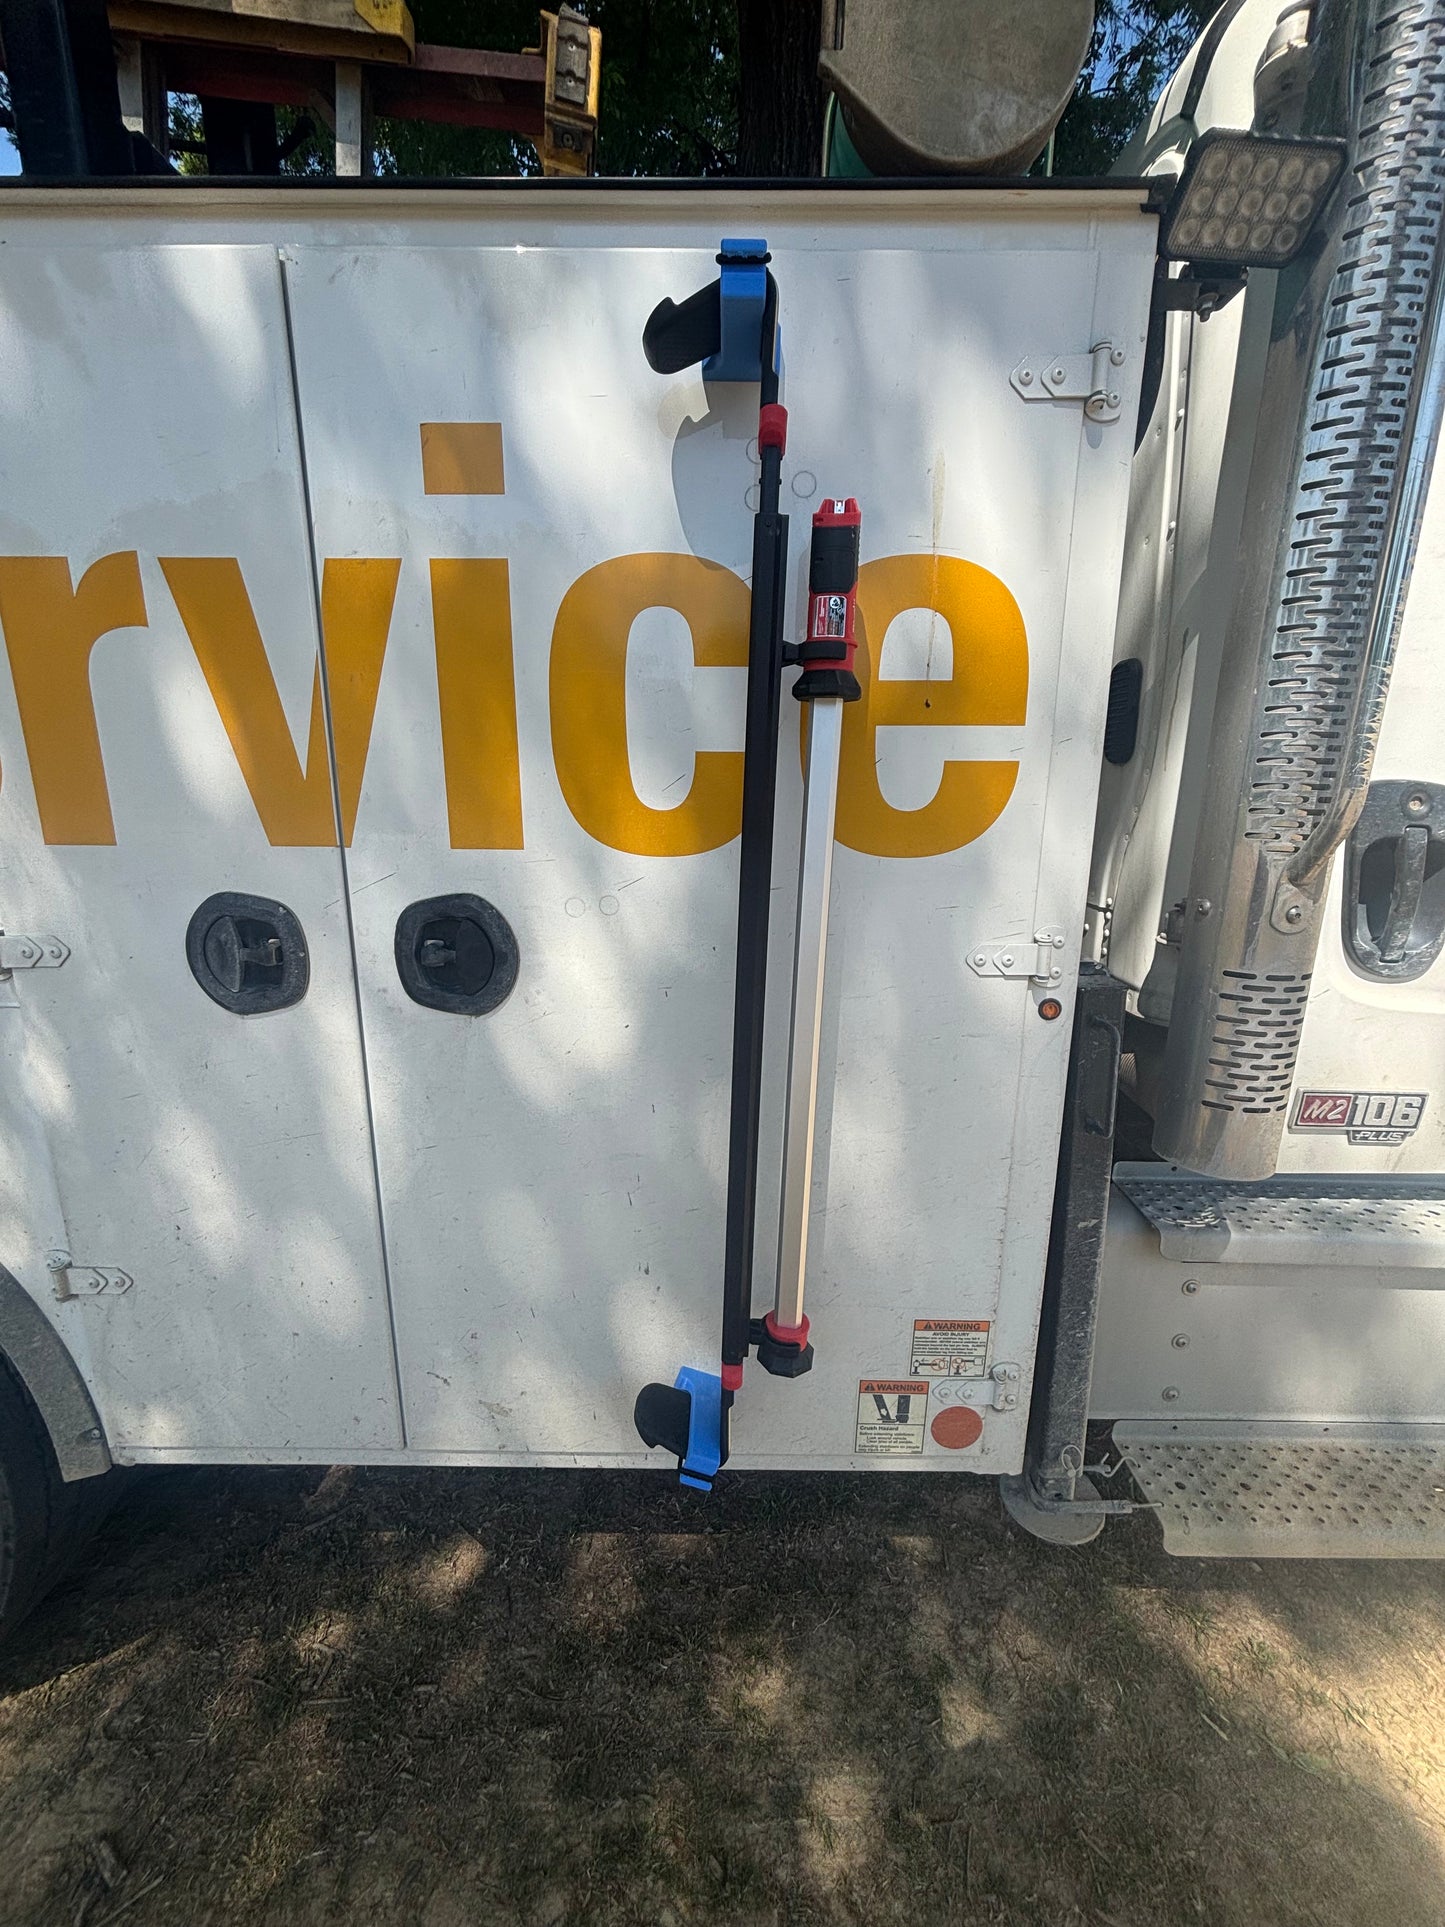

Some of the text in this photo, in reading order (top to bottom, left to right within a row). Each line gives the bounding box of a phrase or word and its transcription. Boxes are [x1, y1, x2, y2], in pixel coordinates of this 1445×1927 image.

[0, 423, 1028, 857] rvice
[1303, 1095, 1423, 1127] M2 106
[1355, 1130, 1405, 1141] PLUS
[933, 1322, 981, 1331] WARNING
[876, 1383, 924, 1392] WARNING
